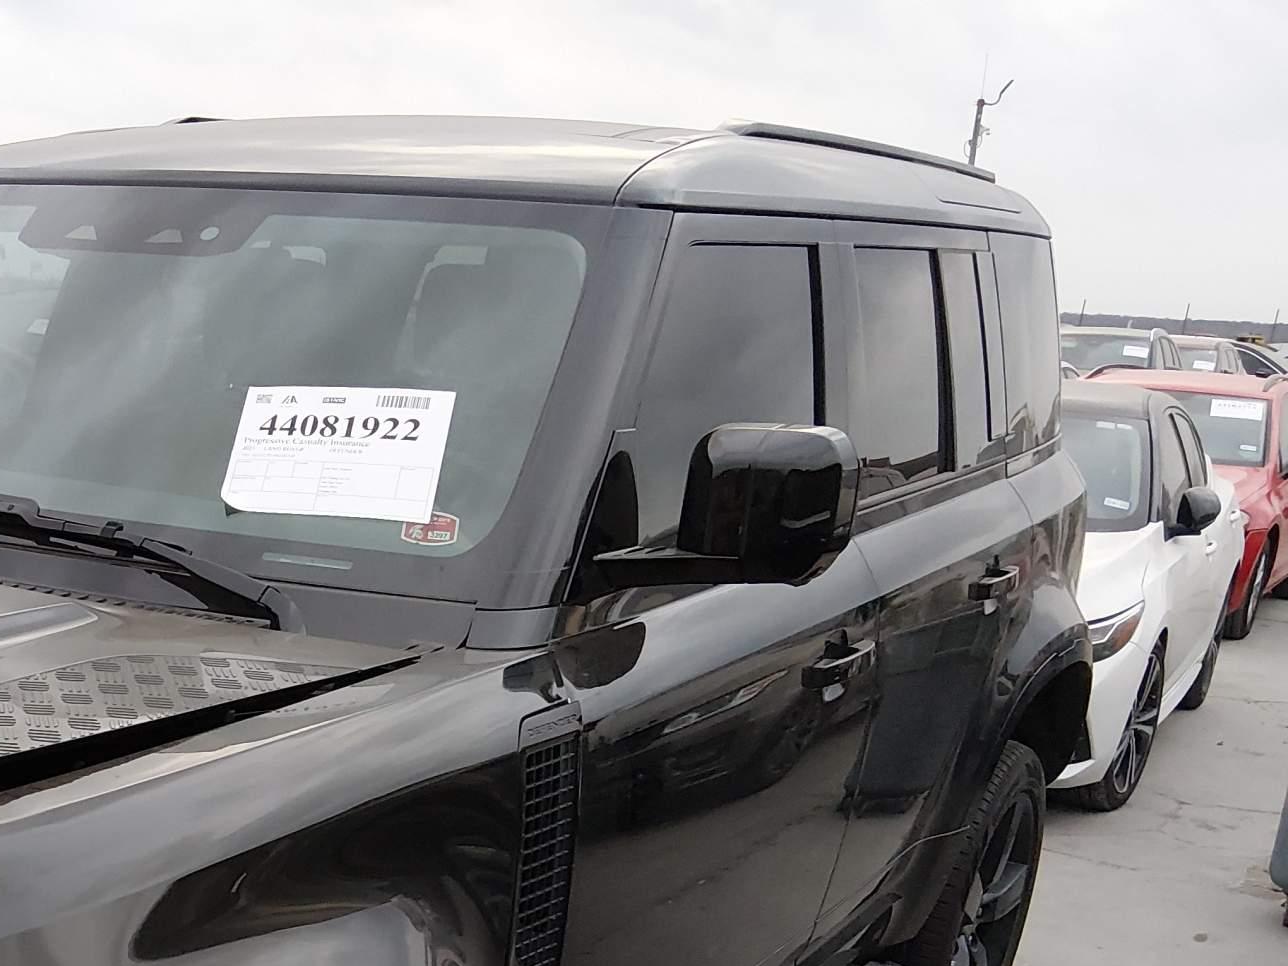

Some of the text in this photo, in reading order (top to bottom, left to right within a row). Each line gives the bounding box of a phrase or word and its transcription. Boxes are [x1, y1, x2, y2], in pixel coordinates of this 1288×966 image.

[259, 414, 421, 441] 44081922
[292, 437, 328, 447] Casualty
[330, 438, 371, 448] Insurance
